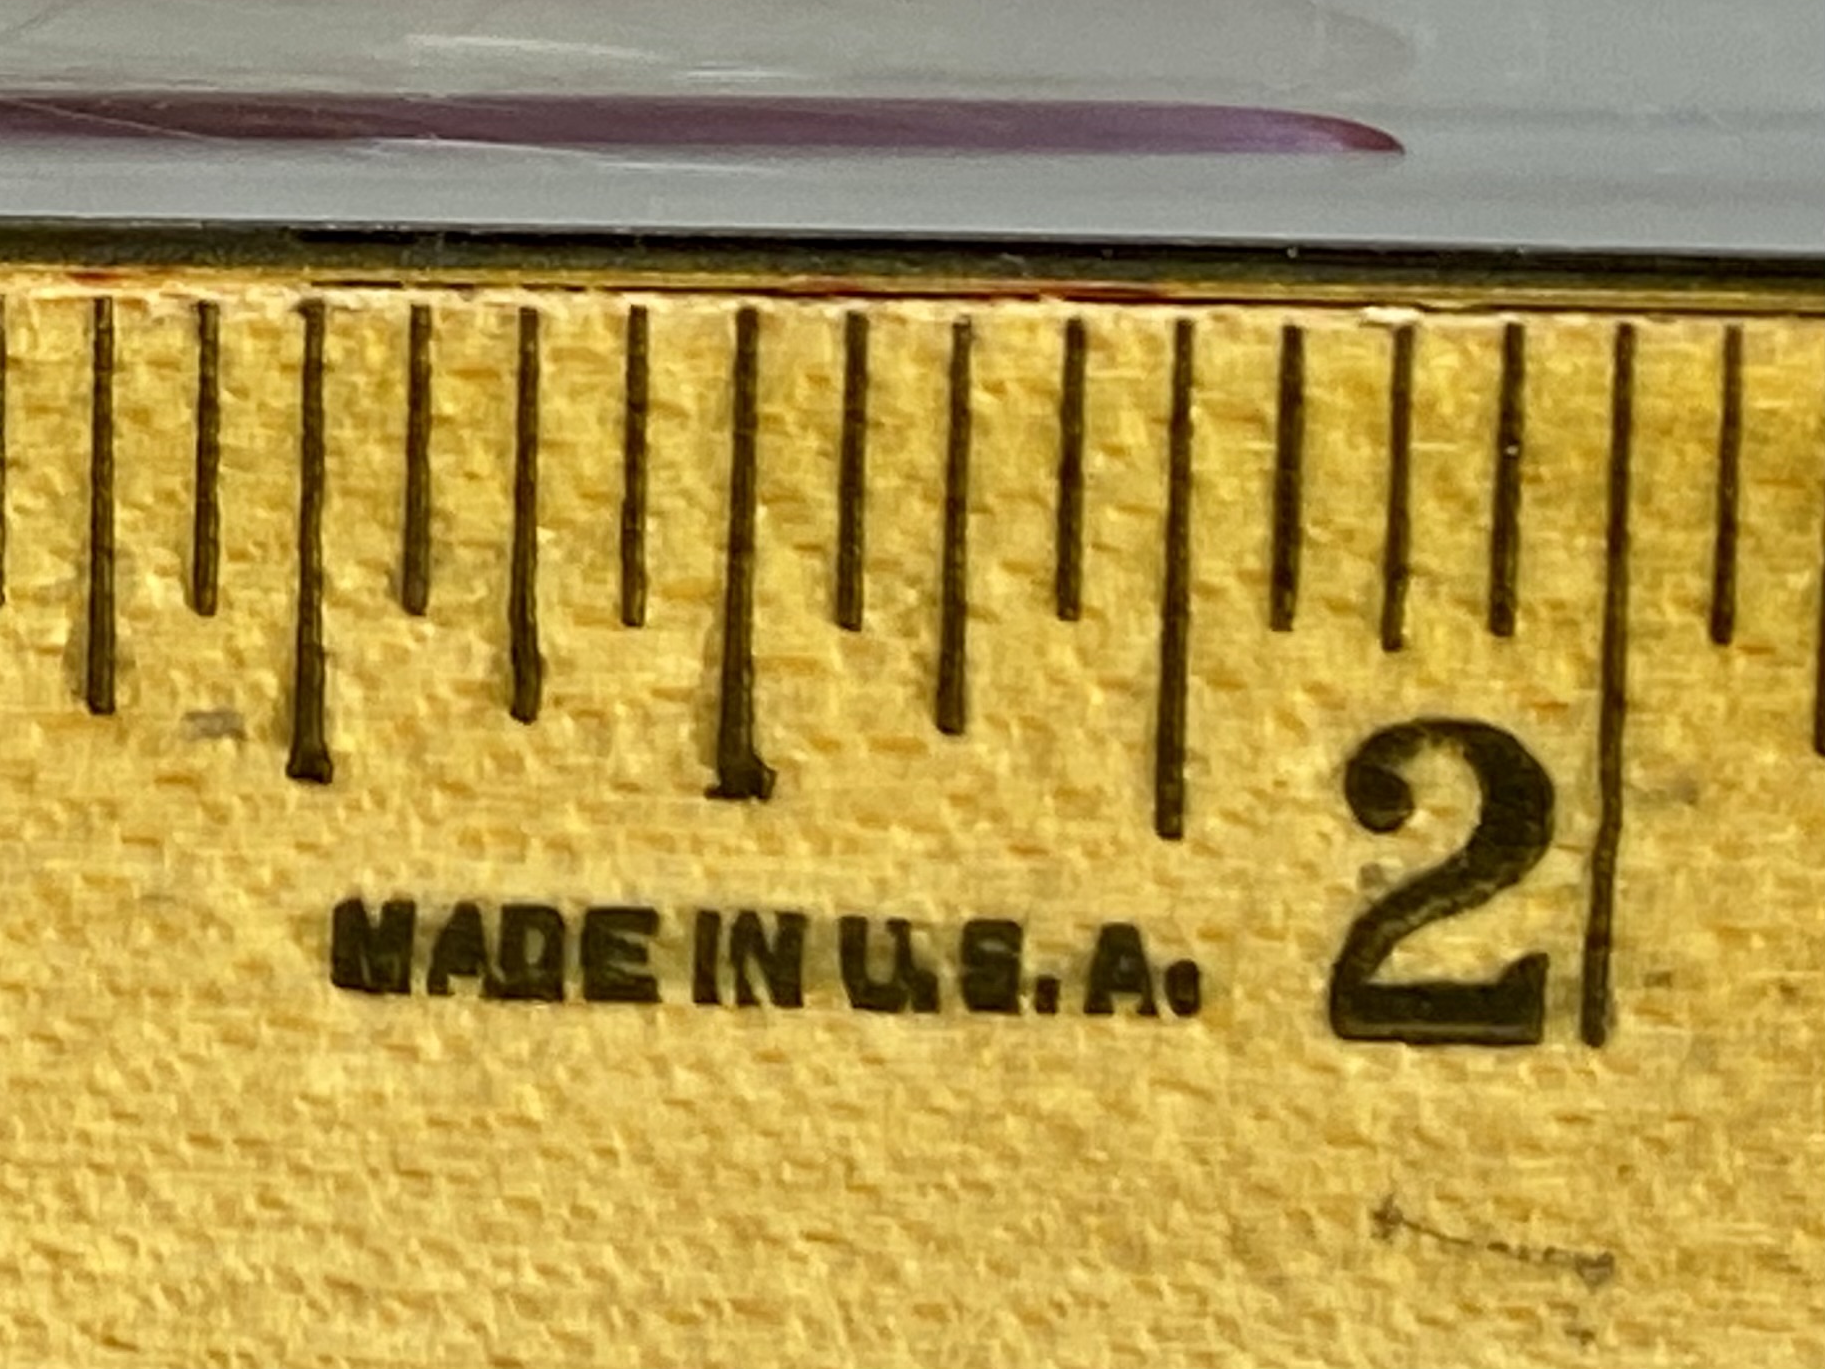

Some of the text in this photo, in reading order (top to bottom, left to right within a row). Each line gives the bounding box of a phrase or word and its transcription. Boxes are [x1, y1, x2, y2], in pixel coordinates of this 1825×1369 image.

[331, 898, 1201, 1018] MADE IN U.S.A.
[1330, 718, 1552, 1042] 2
